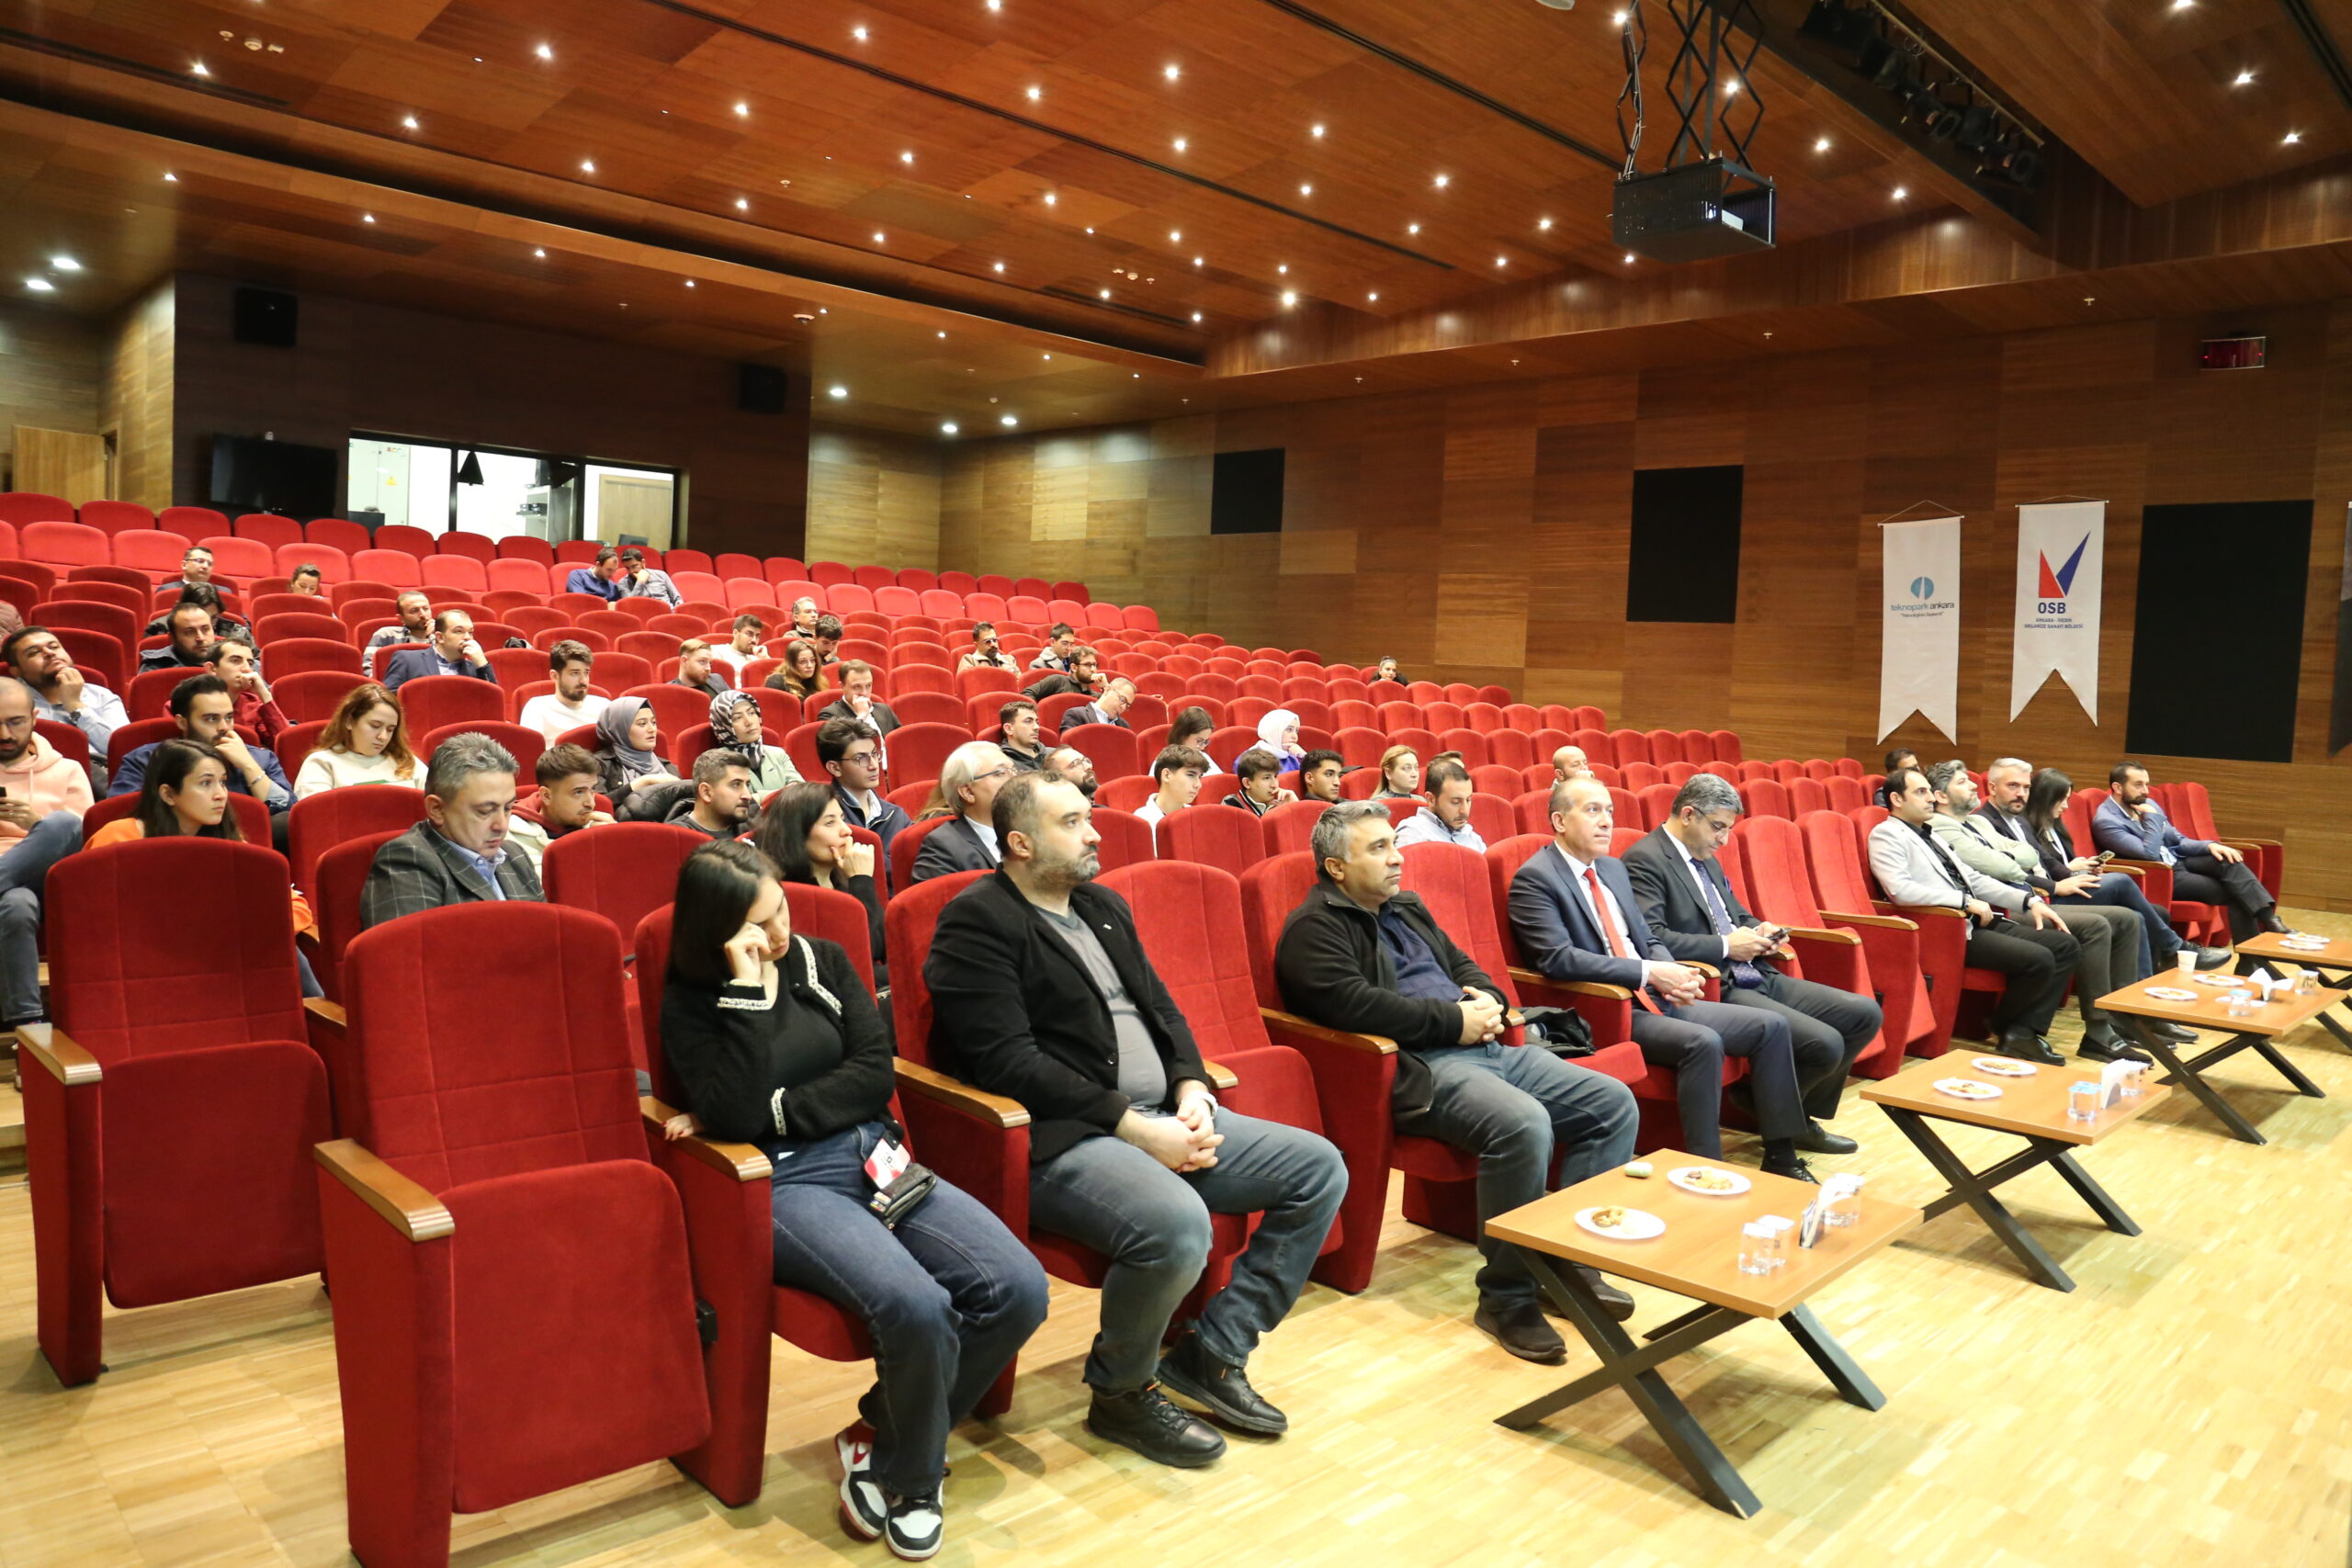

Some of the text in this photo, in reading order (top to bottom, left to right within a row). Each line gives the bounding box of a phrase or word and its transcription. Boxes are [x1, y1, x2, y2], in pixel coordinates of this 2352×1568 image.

[1891, 602, 1954, 612] teknopark ankara
[2038, 603, 2065, 615] OSB
